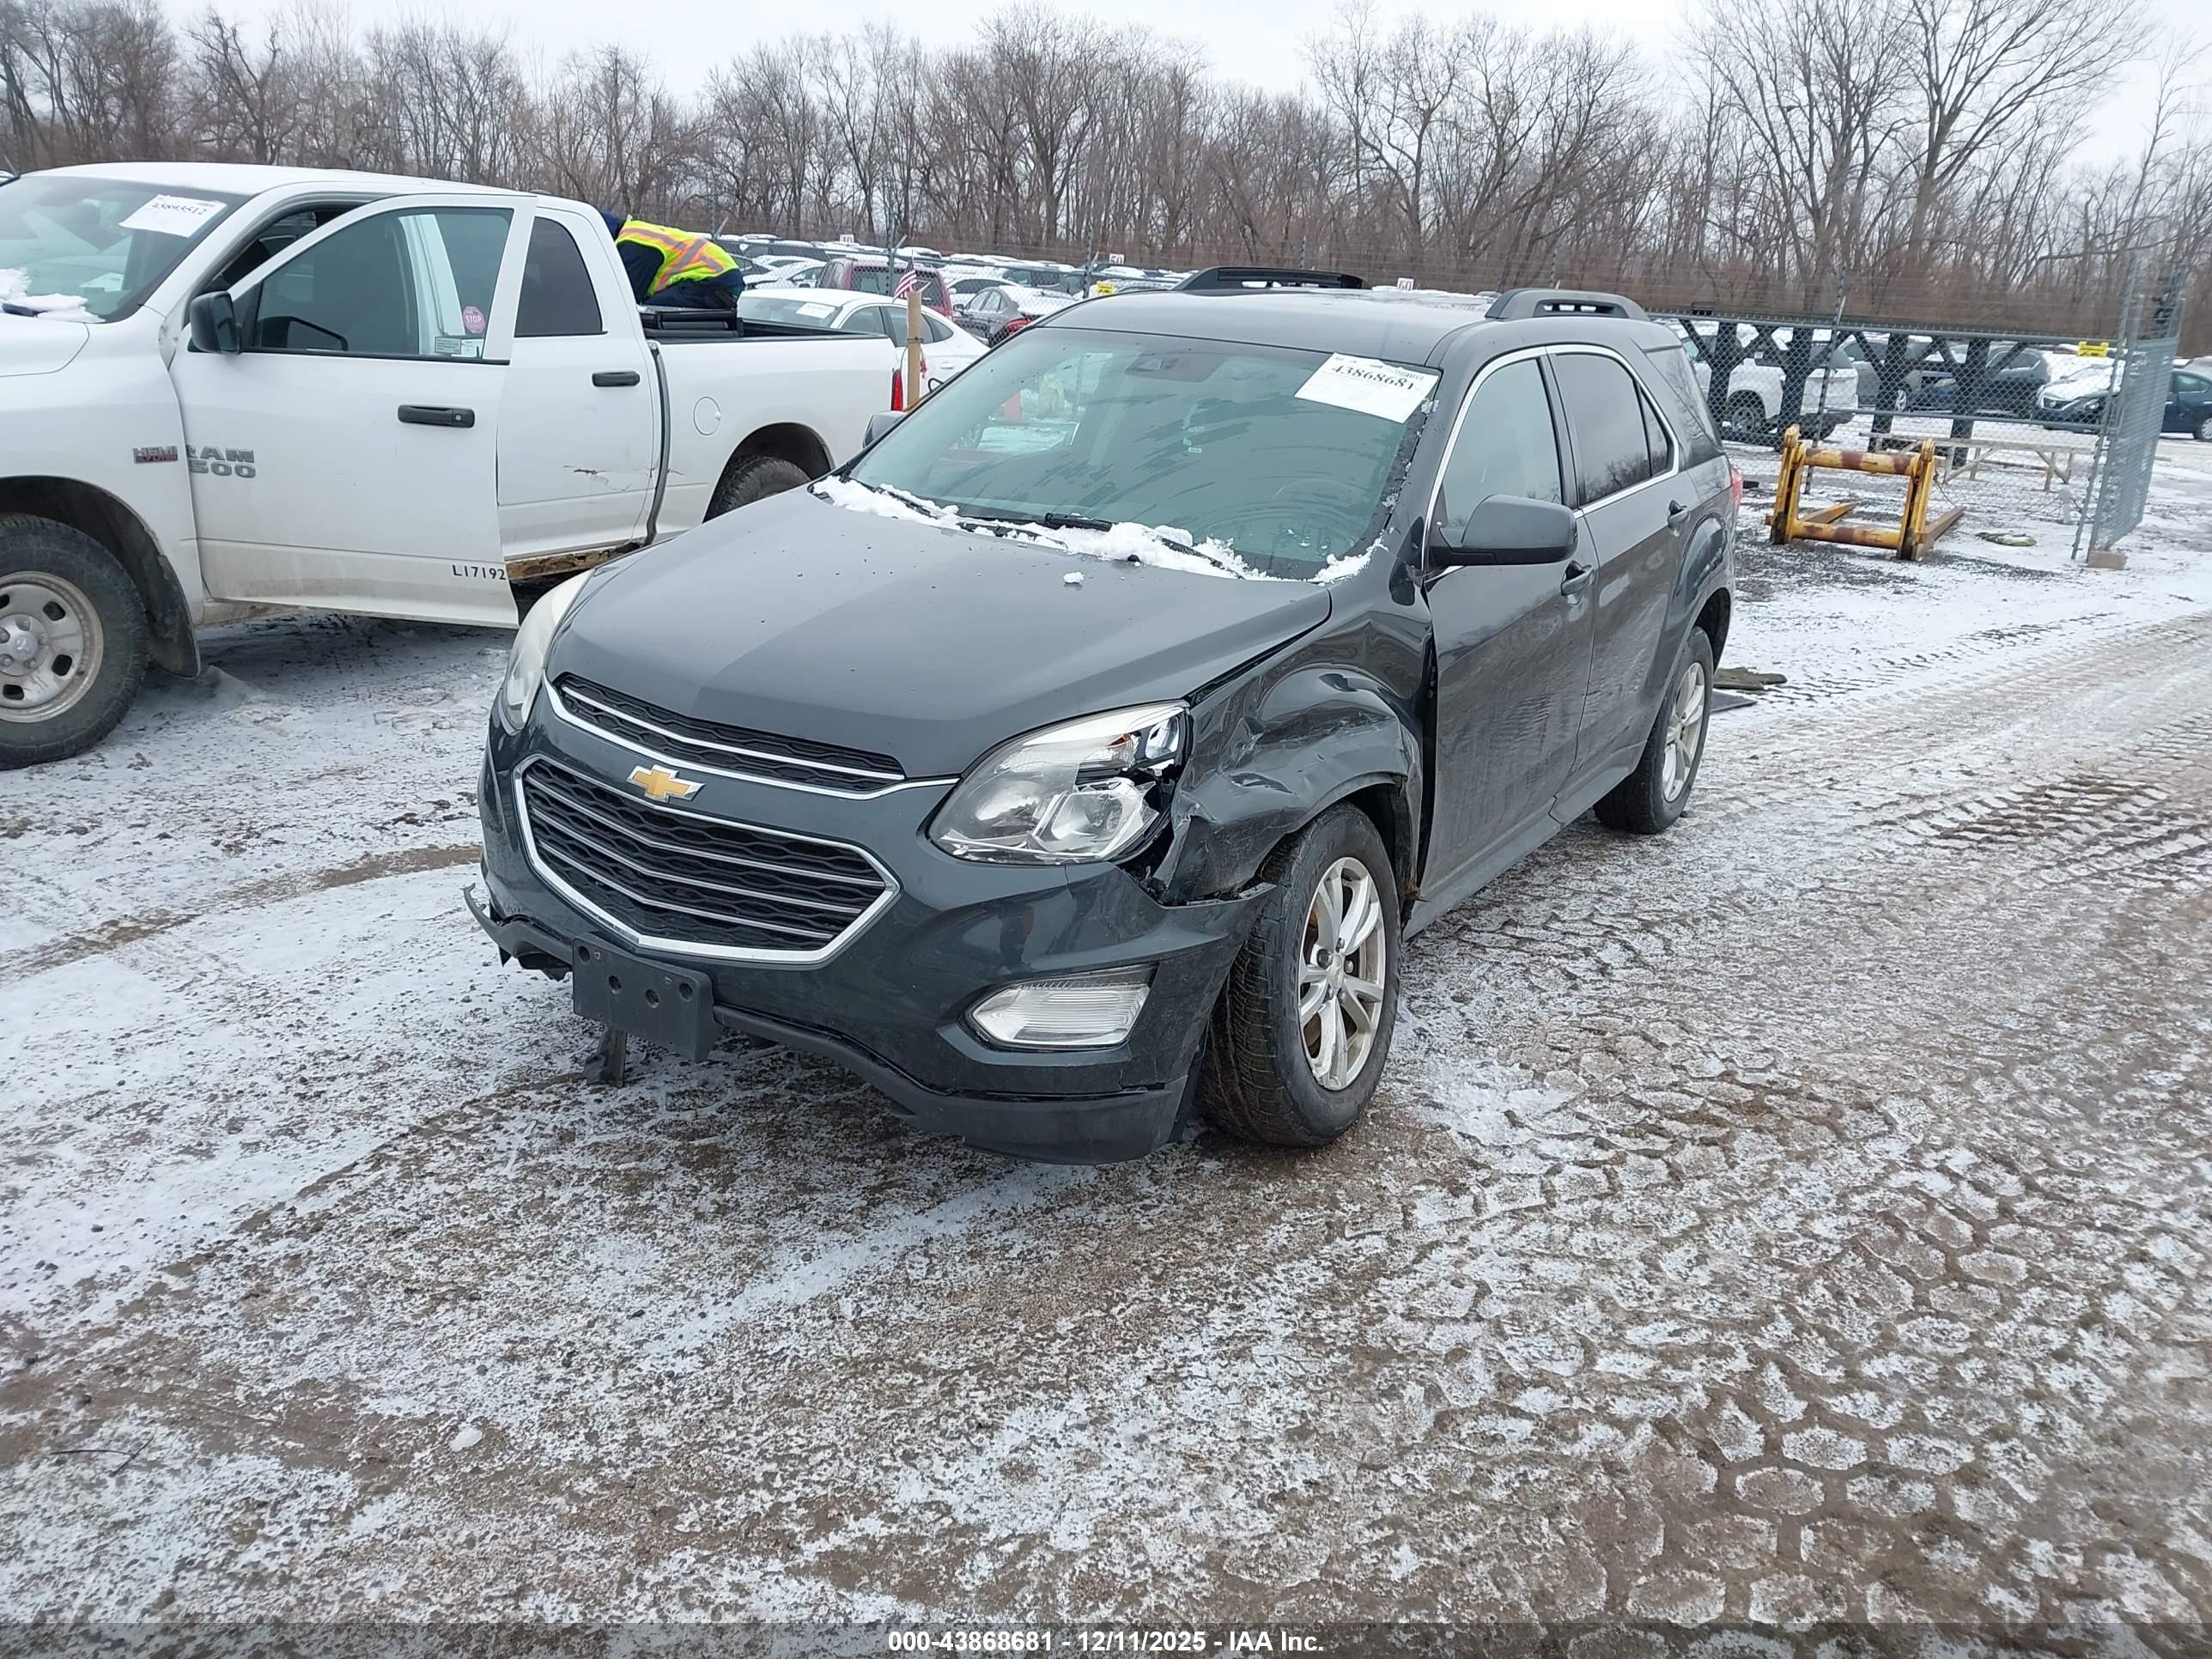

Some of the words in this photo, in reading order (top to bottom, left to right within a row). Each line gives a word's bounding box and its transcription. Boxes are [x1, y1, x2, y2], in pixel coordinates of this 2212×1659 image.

[1110, 255, 1123, 264] 50
[465, 315, 482, 324] STOP
[1332, 364, 1415, 391] 43868681
[133, 446, 178, 457] HEMI
[187, 459, 256, 478] 500
[452, 564, 507, 580] L17192
